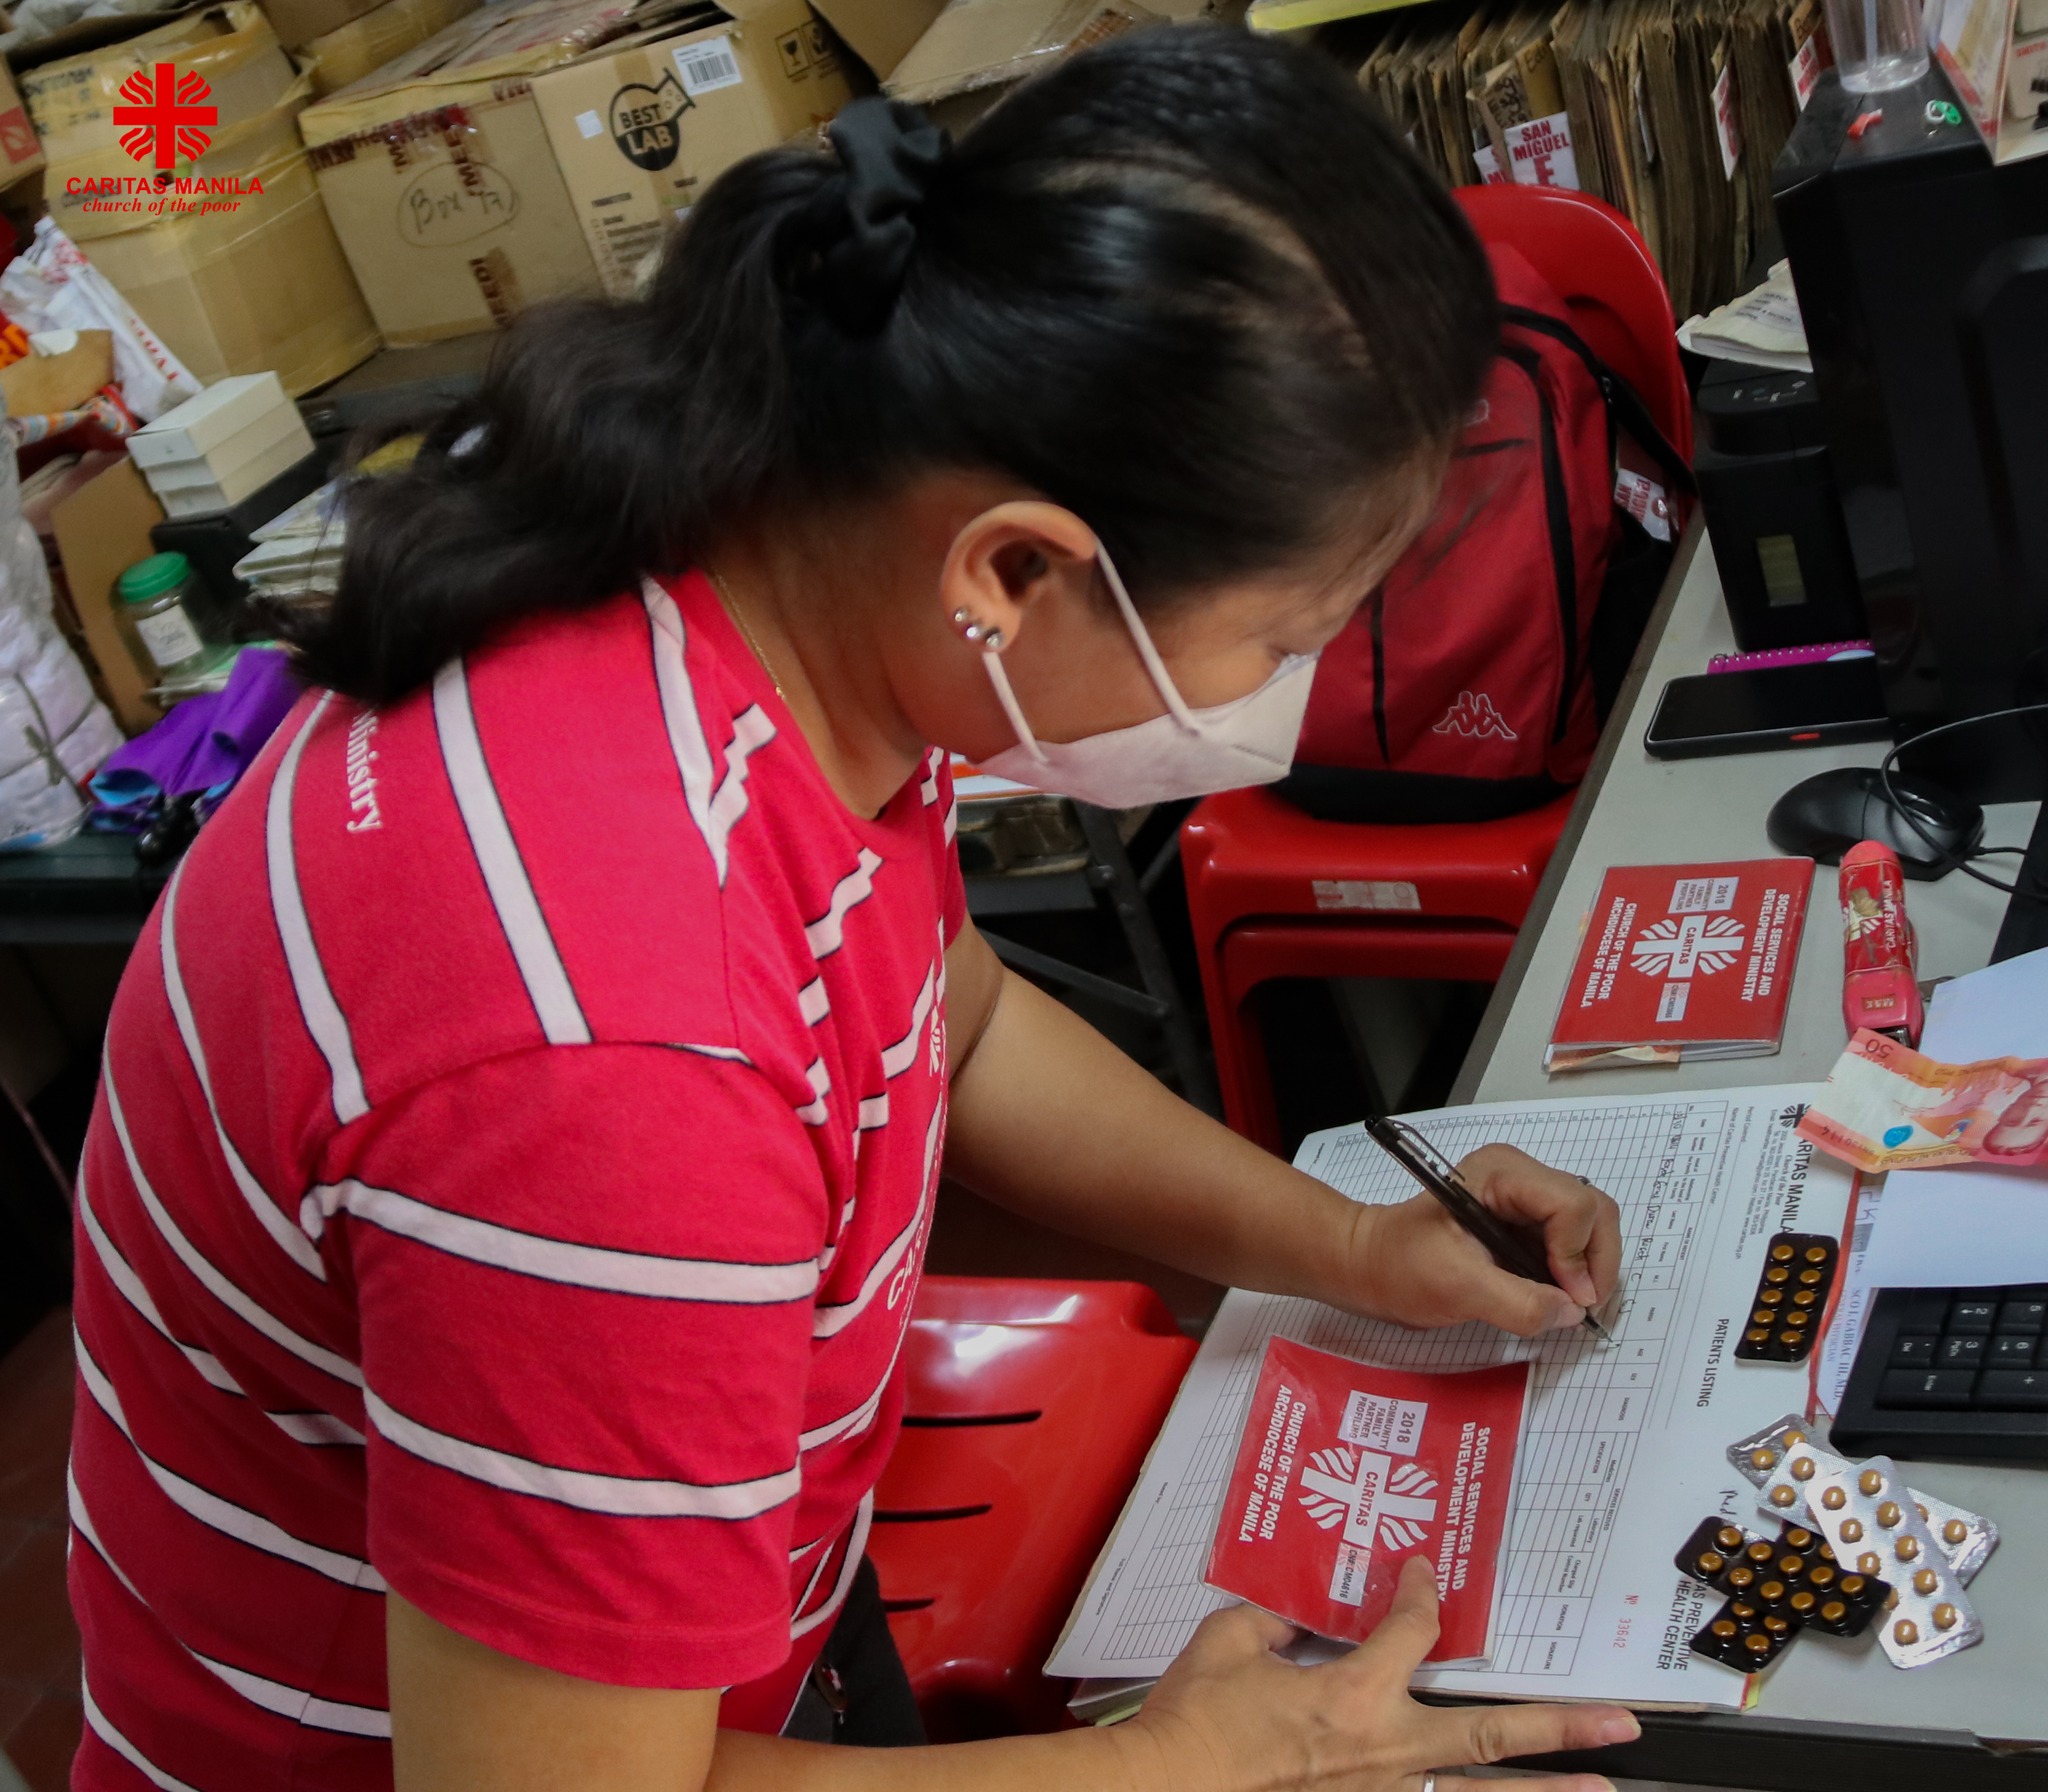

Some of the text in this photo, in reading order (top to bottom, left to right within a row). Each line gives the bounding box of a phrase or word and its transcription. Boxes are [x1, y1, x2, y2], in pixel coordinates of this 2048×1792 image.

[619, 103, 662, 129] BEST
[1521, 120, 1552, 141] SAN
[626, 125, 673, 155] LAB
[1513, 132, 1569, 161] MIGUEL
[1714, 884, 1728, 905] 2018
[1580, 896, 1624, 1007] ARCHDIOCESE OF MANILA
[1597, 902, 1637, 1000] CHURCH OF THE POOR
[1678, 926, 1696, 965] CARITAS
[1740, 888, 1776, 1001] DEVELOPMENT MINISTRY
[1757, 892, 1789, 996] SOCIAL SERVICES AND
[1865, 1039, 1894, 1059] 50
[1774, 1154, 1793, 1206] Church of the Poor
[1791, 1138, 1814, 1180] ARITAS
[1697, 1318, 1729, 1406] PATIENTS LISTING
[1965, 1341, 1978, 1349] 3
[1349, 1396, 1367, 1439] PROFILING
[1359, 1400, 1377, 1438] PARTNER
[1370, 1407, 1385, 1437] FAMILY
[1378, 1399, 1398, 1449] COMMUNITY
[1397, 1411, 1415, 1443] 2018
[1238, 1384, 1292, 1542] ARCHDIOCESE OF MANILA
[1259, 1401, 1306, 1539] CHURCH OF THE POOR
[1446, 1422, 1474, 1524] DEVELOPMENT
[1356, 1471, 1378, 1526] CARITAS
[1451, 1427, 1489, 1589] SOCIAL SERVICES AND
[1556, 1604, 1568, 1631] DONATION
[1613, 1619, 1631, 1648] 33642
[1657, 1580, 1691, 1670] HEALTH CENTER
[1674, 1602, 1703, 1670] PREVENTIVE
[1543, 1640, 1557, 1670] SIGNATURE
